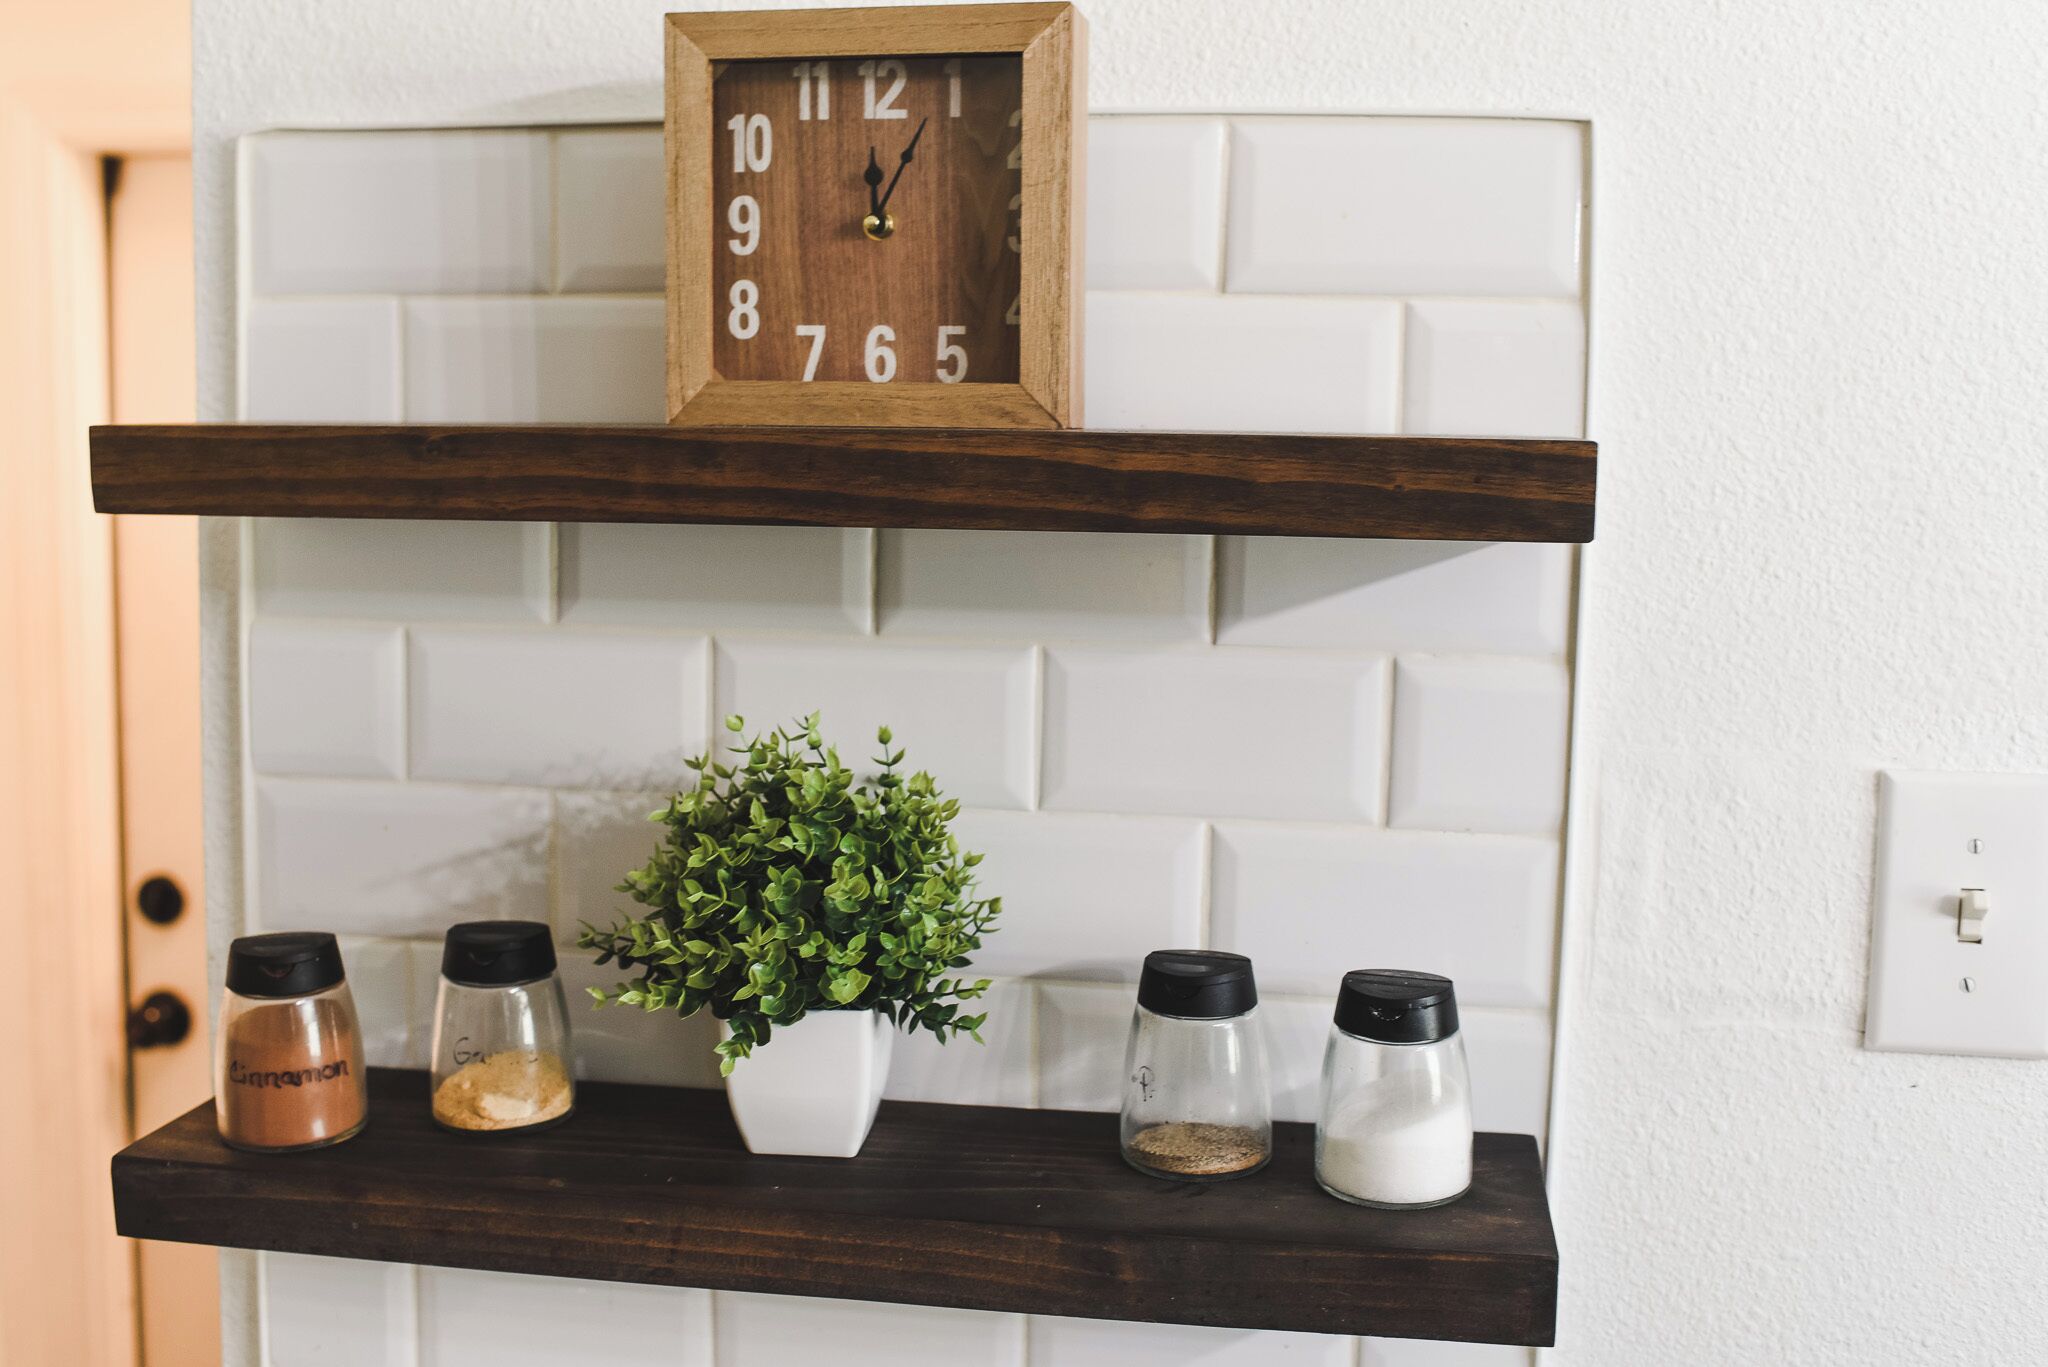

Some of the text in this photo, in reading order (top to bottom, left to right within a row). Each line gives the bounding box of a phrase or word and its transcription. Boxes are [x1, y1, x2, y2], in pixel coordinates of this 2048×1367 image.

[793, 62, 829, 120] 11
[859, 60, 907, 119] 12
[944, 60, 961, 117] 1
[728, 114, 772, 172] 10
[728, 195, 760, 256] 9
[728, 279, 760, 339] 8
[796, 325, 826, 381] 7
[864, 325, 896, 383] 6
[936, 326, 968, 383] 5
[230, 1060, 349, 1088] Cinnamon
